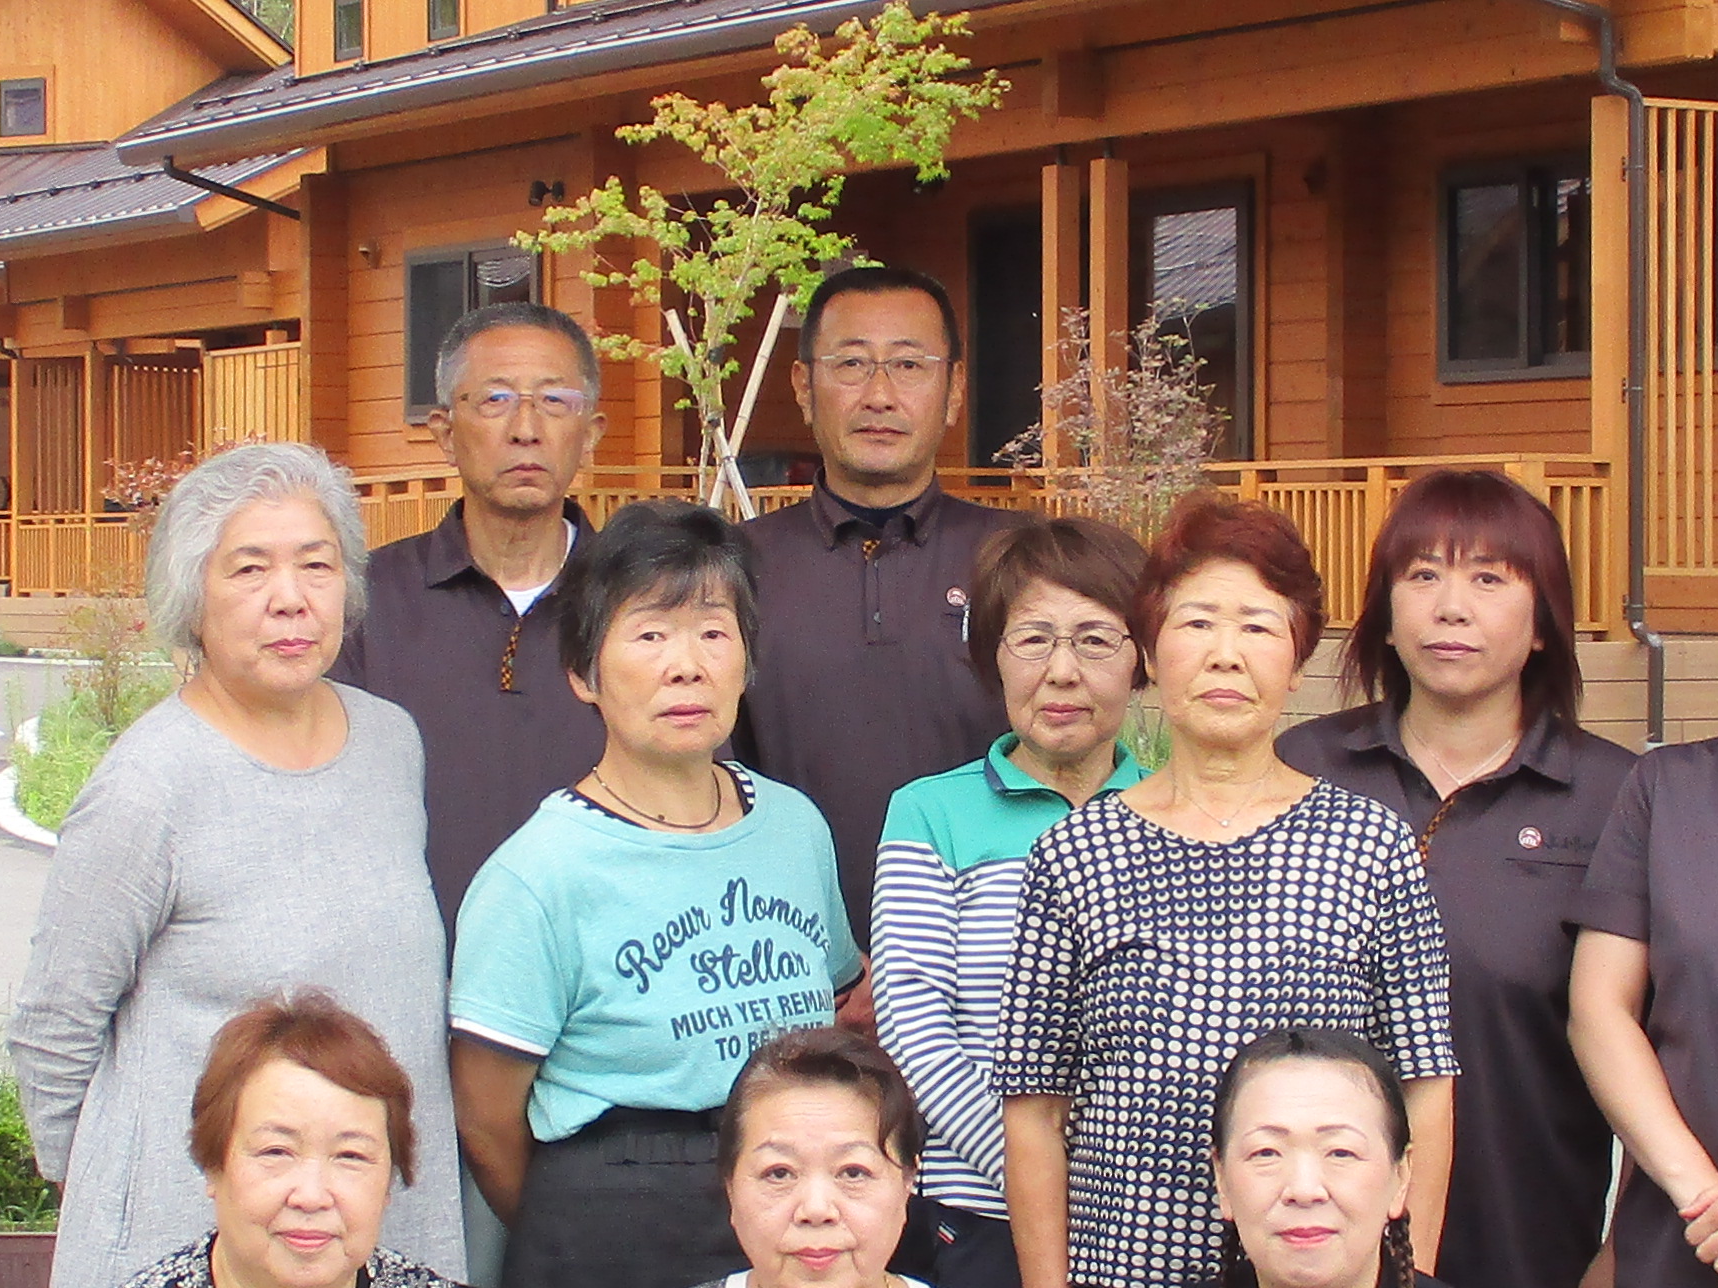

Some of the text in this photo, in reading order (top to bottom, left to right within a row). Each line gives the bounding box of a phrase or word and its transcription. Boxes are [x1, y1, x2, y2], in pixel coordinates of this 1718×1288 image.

[614, 905, 711, 995] Recur
[689, 937, 811, 994] Stellar
[670, 1004, 733, 1041] MUCH
[735, 997, 773, 1025] YET
[714, 1034, 742, 1061] TO
